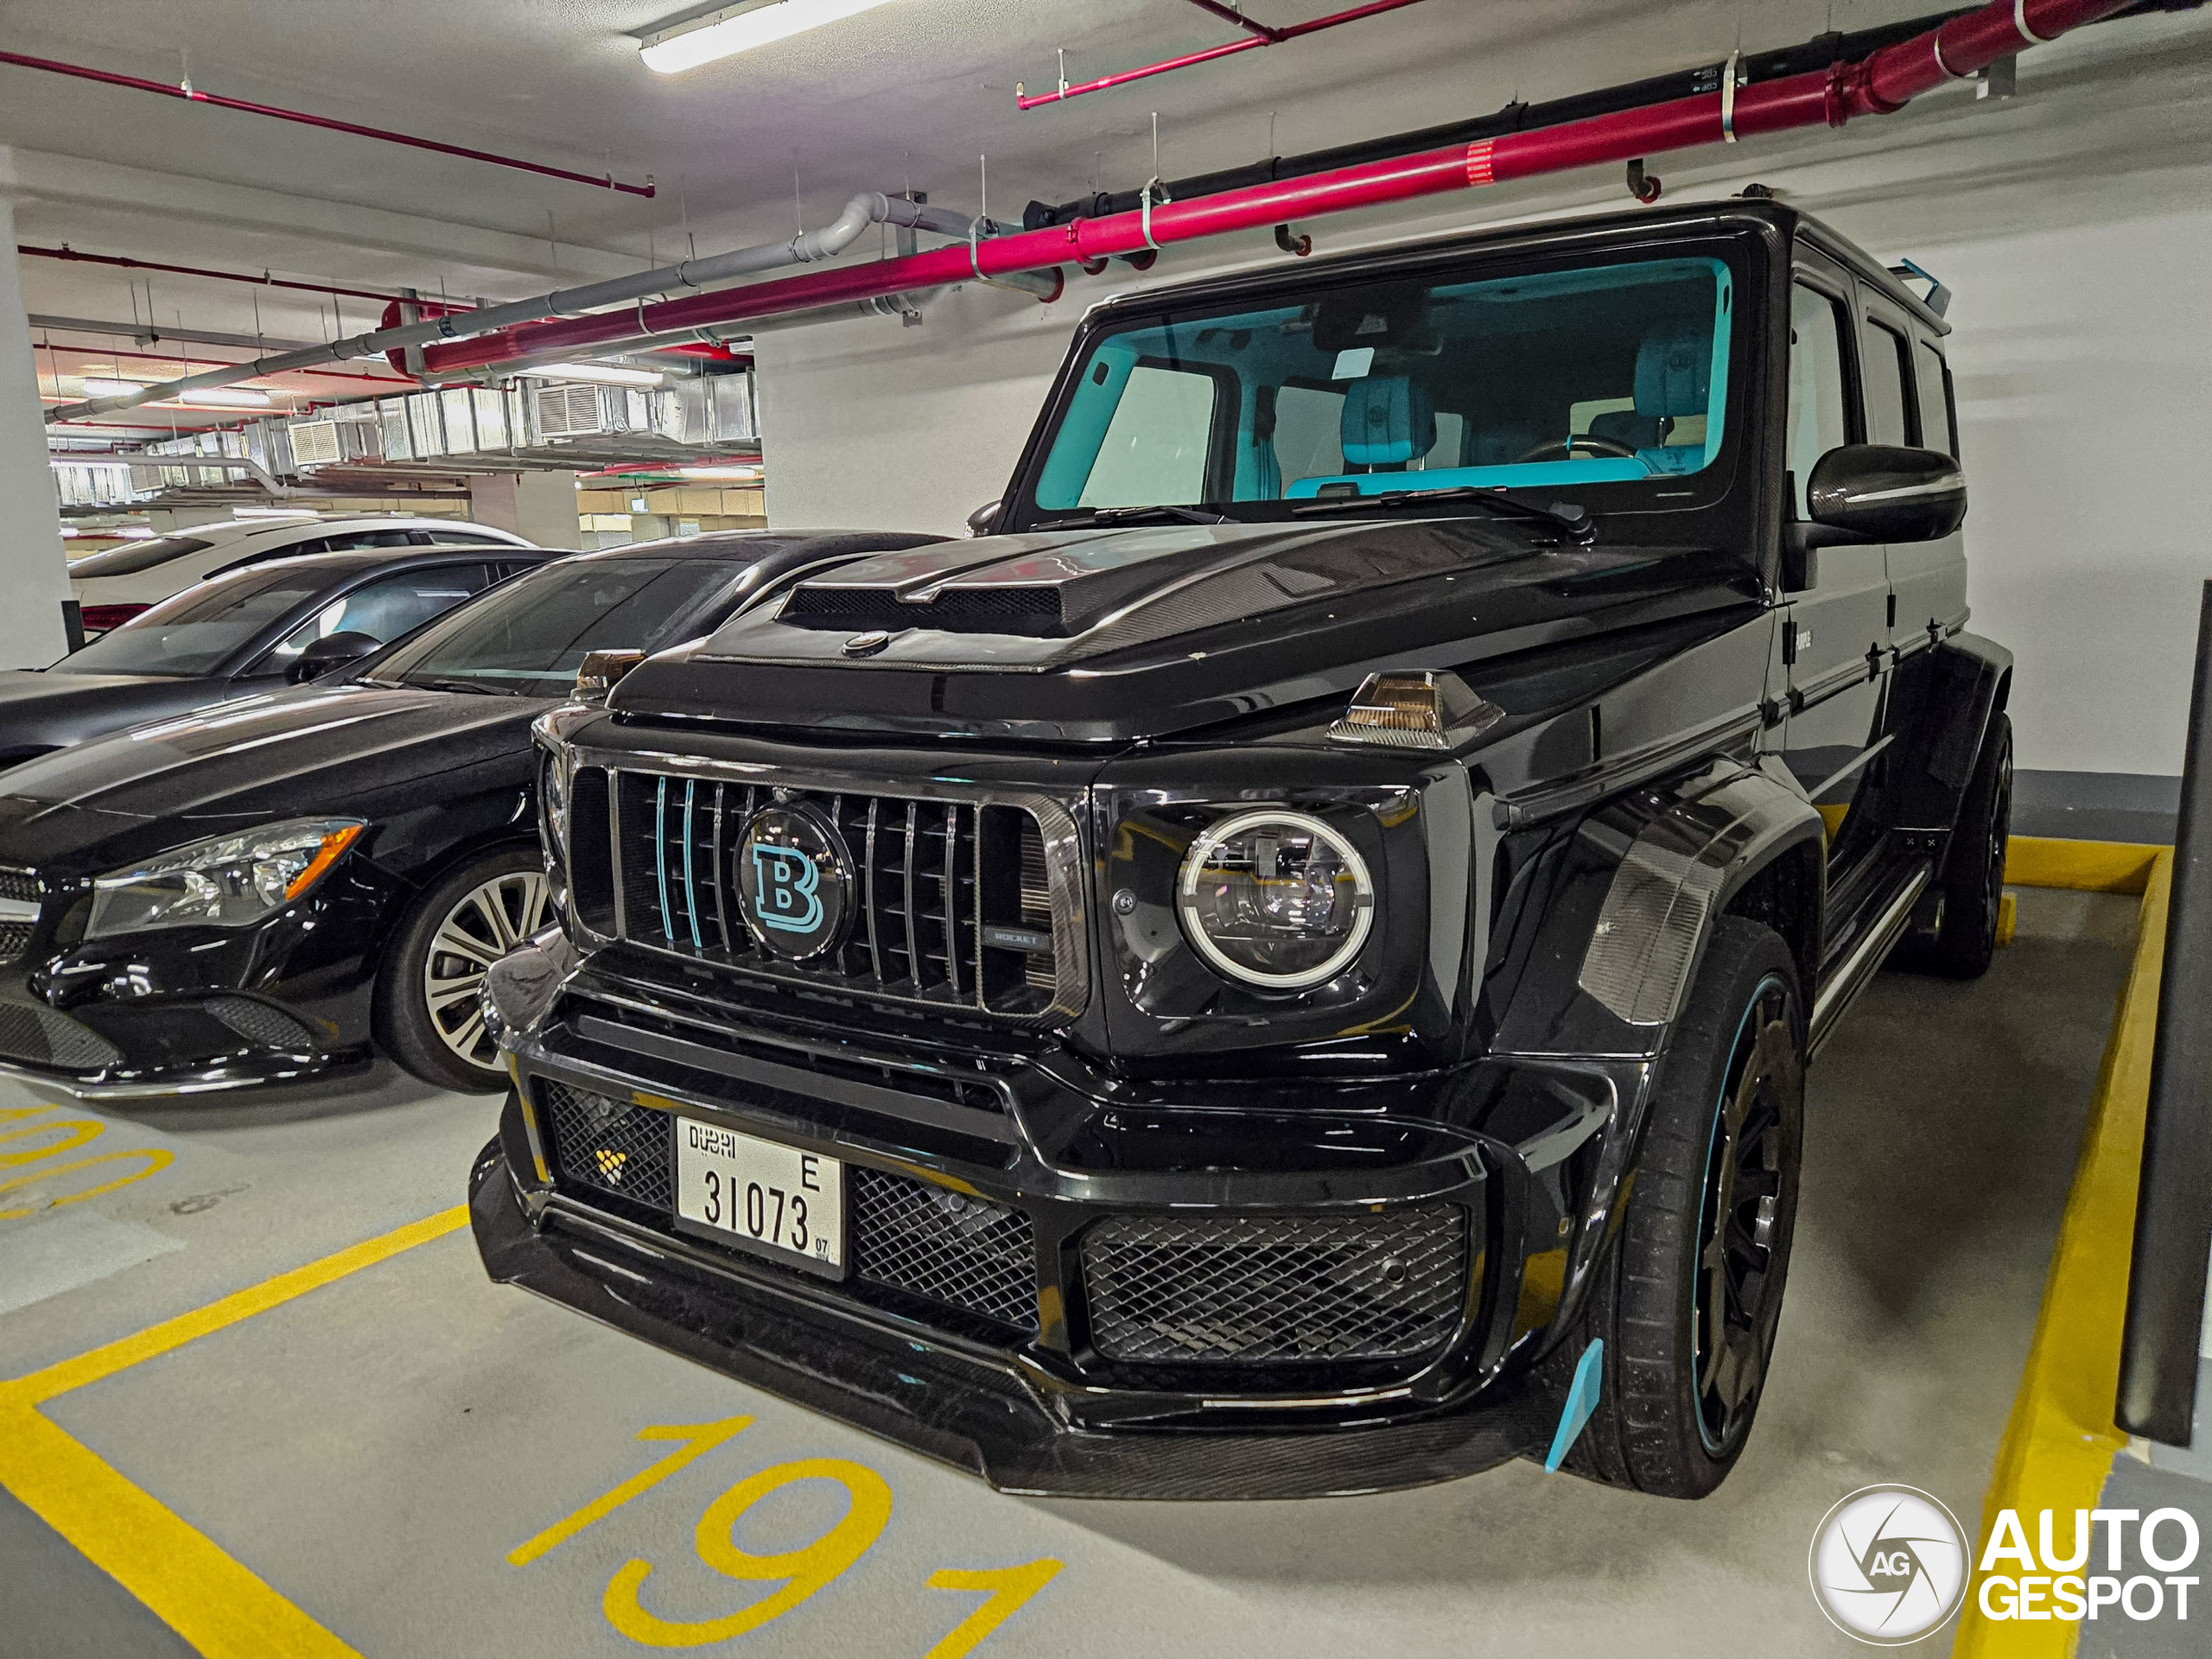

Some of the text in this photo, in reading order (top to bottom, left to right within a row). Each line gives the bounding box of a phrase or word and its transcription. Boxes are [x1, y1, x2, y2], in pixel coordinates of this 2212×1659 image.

[995, 932, 1038, 944] ROCKET
[800, 1153, 821, 1192] E
[704, 1170, 809, 1251] 31073
[815, 1237, 828, 1253] 07
